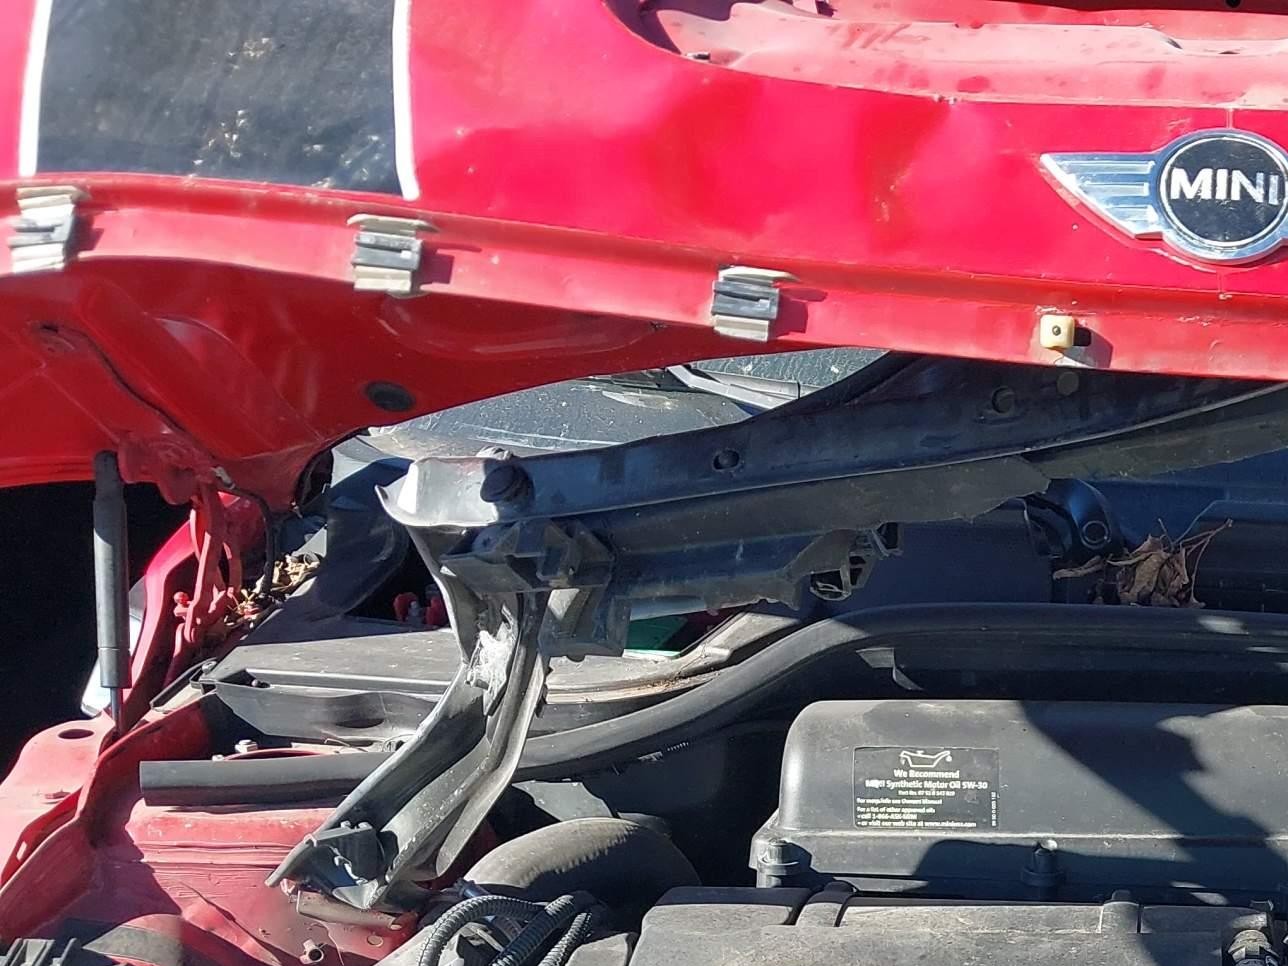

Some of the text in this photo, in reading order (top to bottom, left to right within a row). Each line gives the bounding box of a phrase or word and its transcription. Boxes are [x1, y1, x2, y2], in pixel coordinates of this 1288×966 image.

[1170, 167, 1279, 206] MINI
[893, 769, 960, 778] We Recommend
[886, 780, 923, 789] Synthetic
[924, 781, 948, 789] Motor
[949, 781, 961, 789] Oil
[962, 781, 988, 789] 5W-30
